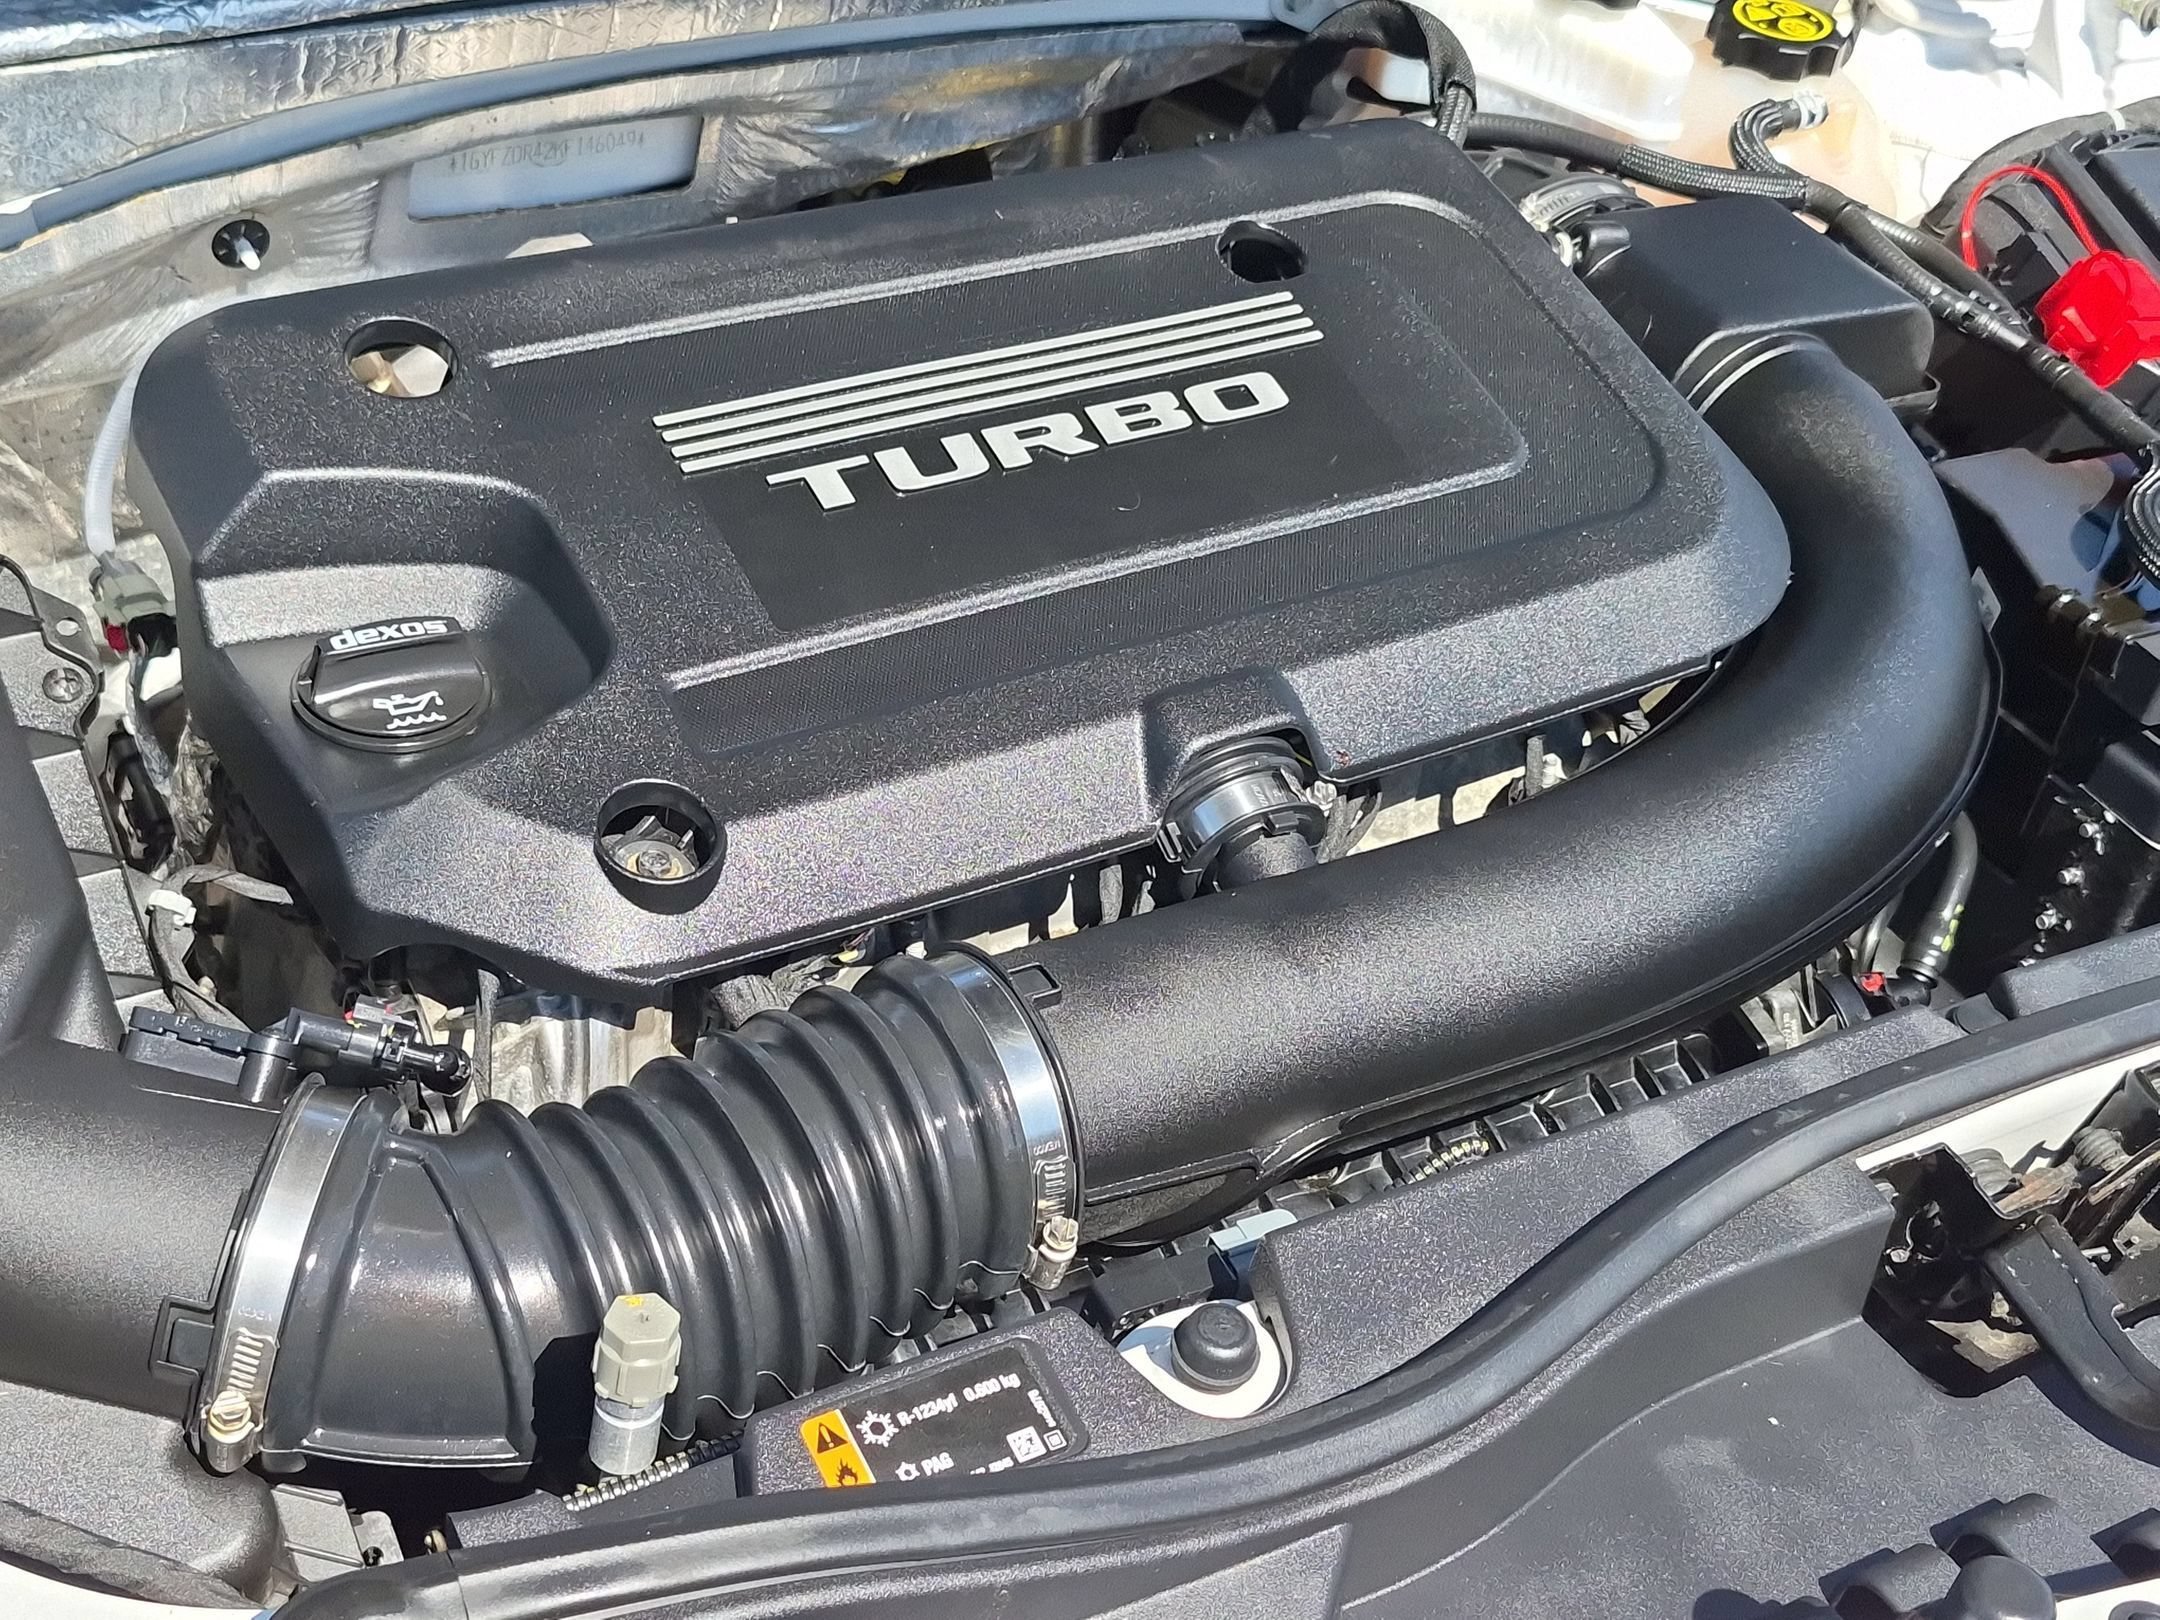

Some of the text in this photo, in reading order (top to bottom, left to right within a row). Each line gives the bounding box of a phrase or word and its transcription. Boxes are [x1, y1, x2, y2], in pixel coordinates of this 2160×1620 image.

[766, 371, 1290, 511] TURBO
[329, 620, 448, 651] dexos
[999, 1372, 1022, 1390] kg
[920, 1451, 955, 1477] PAG
